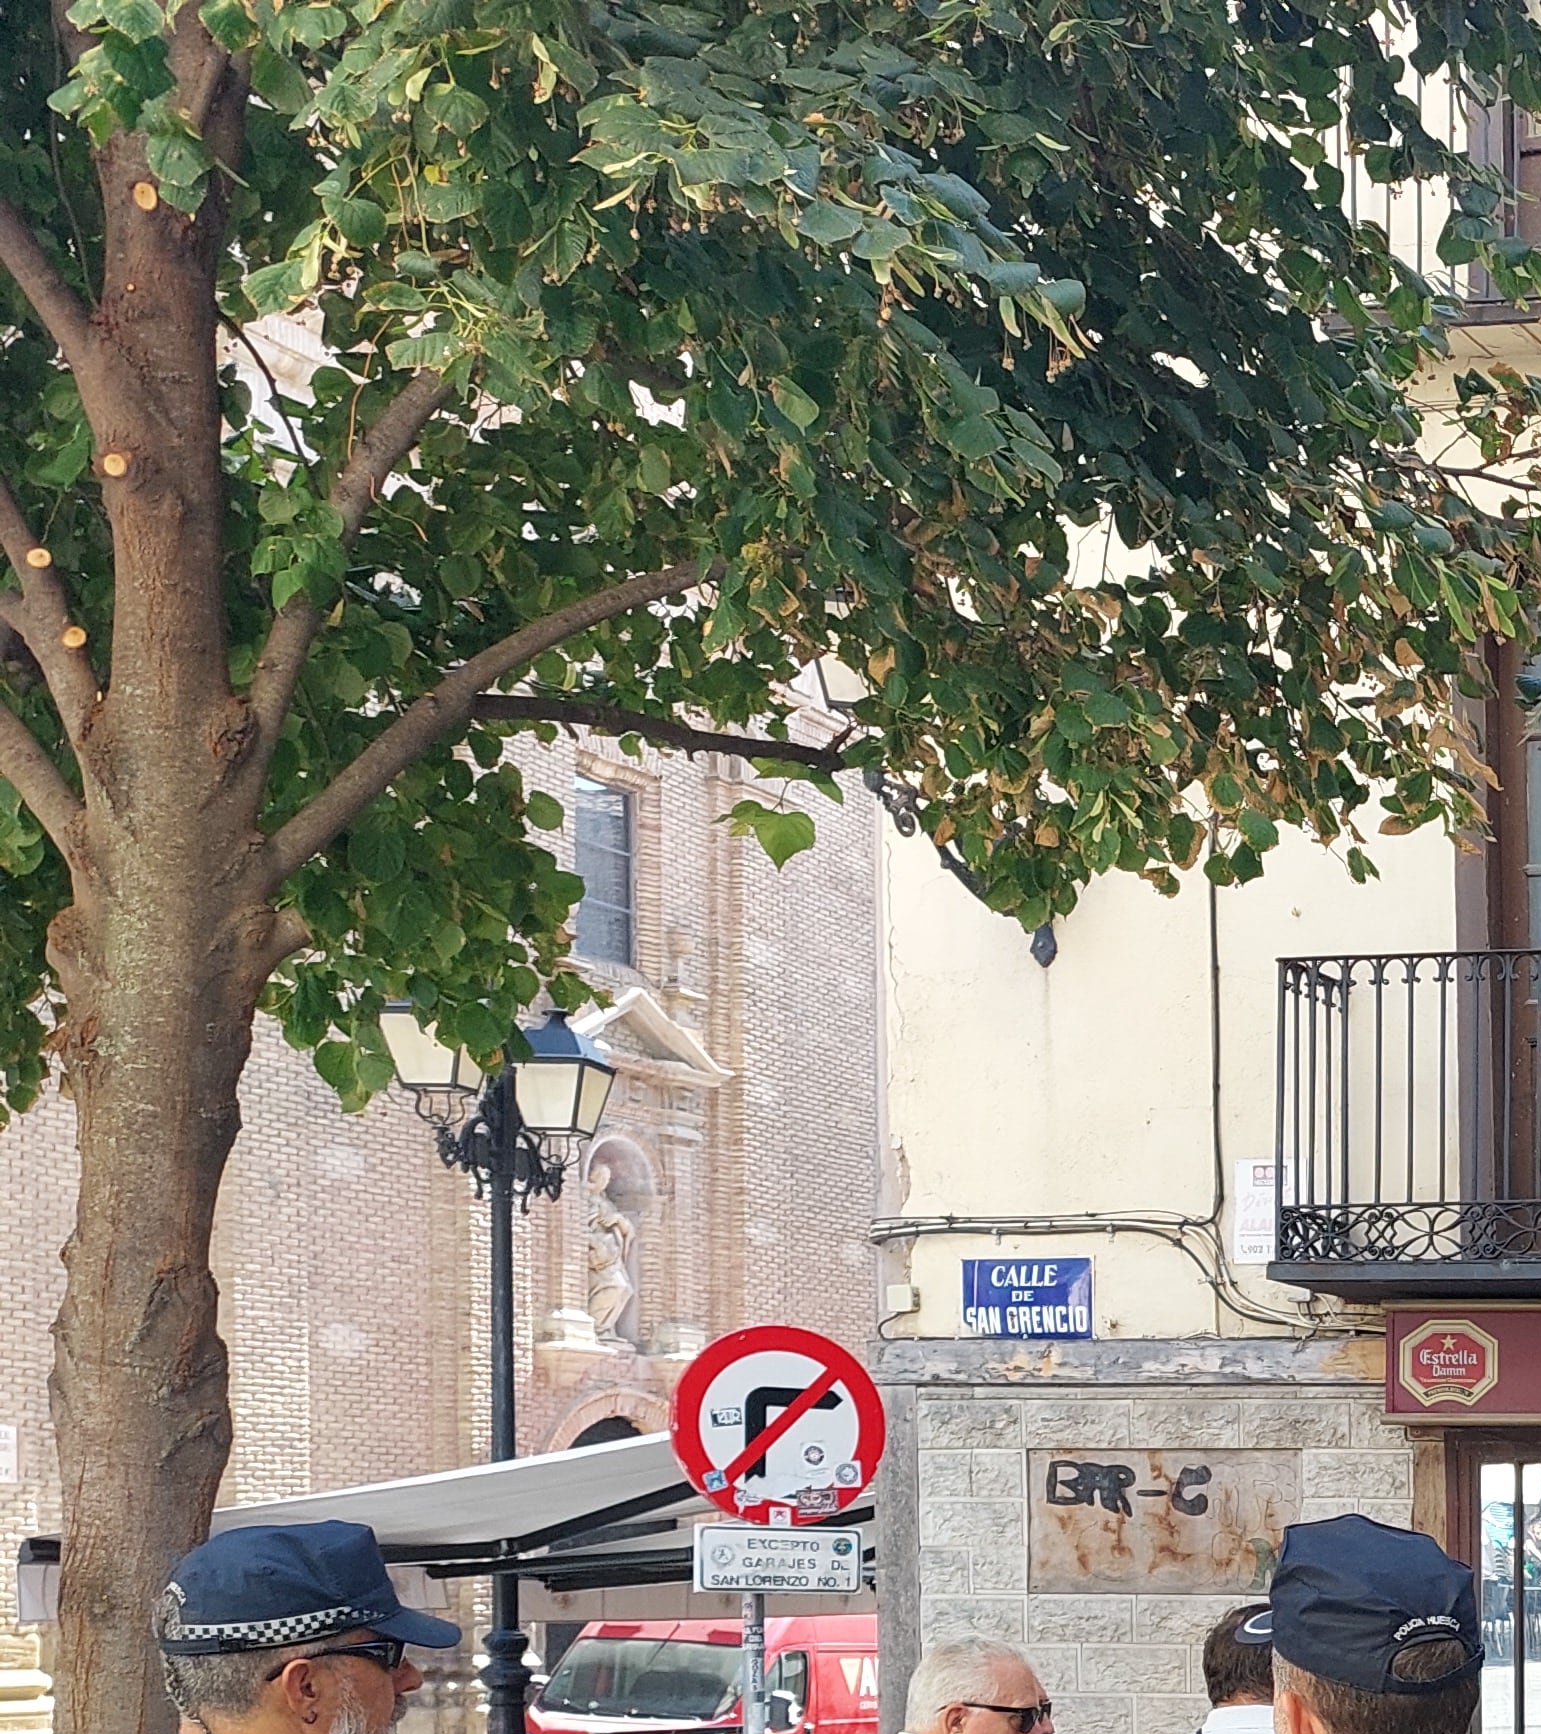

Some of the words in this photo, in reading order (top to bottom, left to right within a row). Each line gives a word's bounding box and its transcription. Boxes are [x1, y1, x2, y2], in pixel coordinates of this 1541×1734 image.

[991, 1264, 1058, 1287] CALLE
[1011, 1290, 1034, 1302] DE
[966, 1306, 1002, 1334] SAN
[1420, 1348, 1478, 1365] Estrella
[1432, 1365, 1466, 1377] Damm
[747, 1538, 820, 1552] EXCEPTO
[742, 1557, 817, 1570] GARAJES
[711, 1575, 739, 1586] SAN
[745, 1574, 810, 1587] LORENZO
[1426, 1615, 1461, 1632] HUESCA
